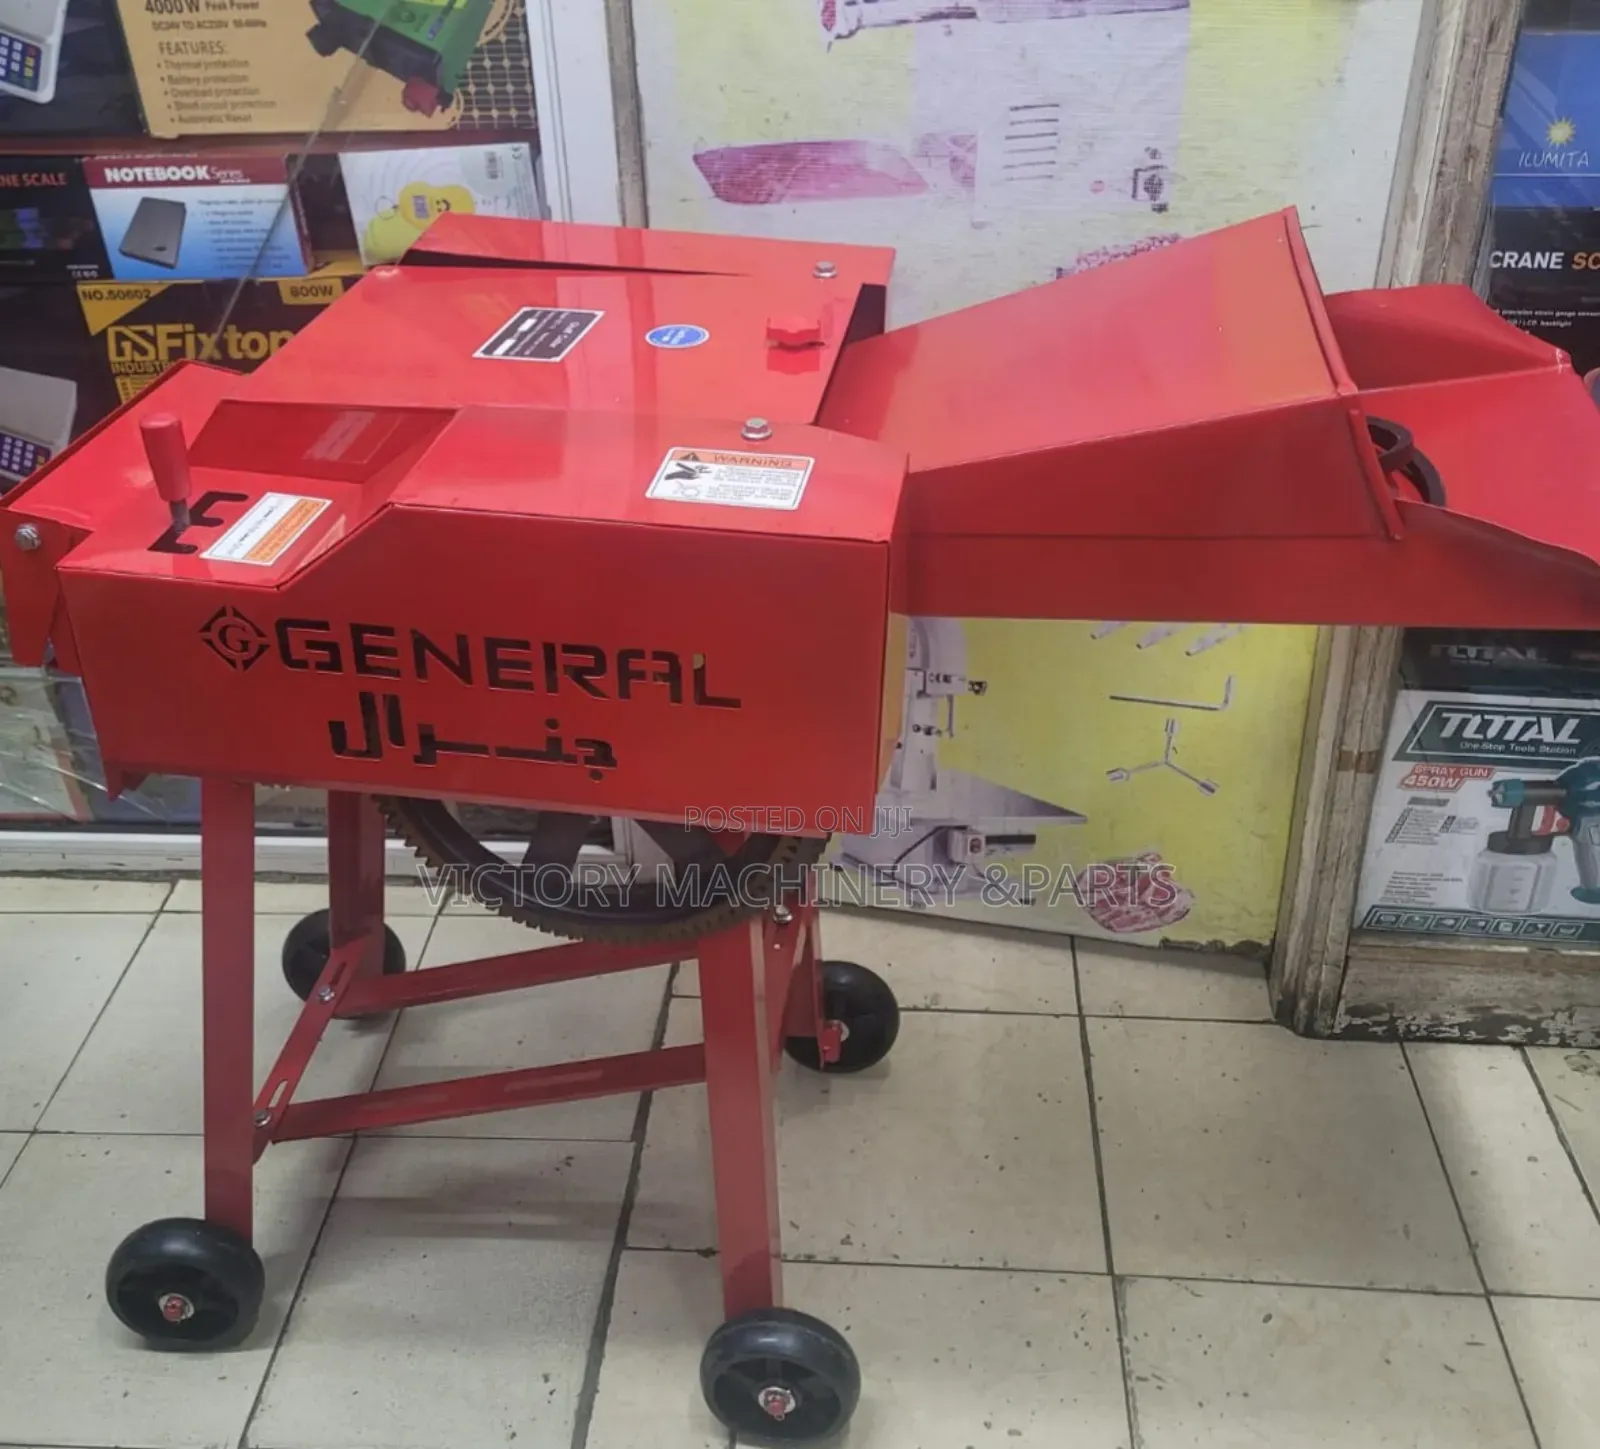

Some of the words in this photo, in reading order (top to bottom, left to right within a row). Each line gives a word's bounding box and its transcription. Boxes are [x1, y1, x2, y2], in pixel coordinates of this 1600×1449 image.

[1518, 149, 1589, 168] ILUMITA
[21, 172, 68, 187] SCALE
[103, 165, 212, 183] NOTEBOOK
[1490, 250, 1565, 269] CRANE
[713, 453, 793, 468] WARNING
[274, 617, 742, 710] GENERAL
[327, 691, 618, 783] جنرال
[1438, 711, 1582, 745] TOTAL
[1509, 743, 1536, 753] Tools
[1539, 745, 1577, 755] Station
[1414, 764, 1457, 776] SPRAY
[1459, 767, 1488, 777] GUN
[1403, 774, 1461, 788] 450W
